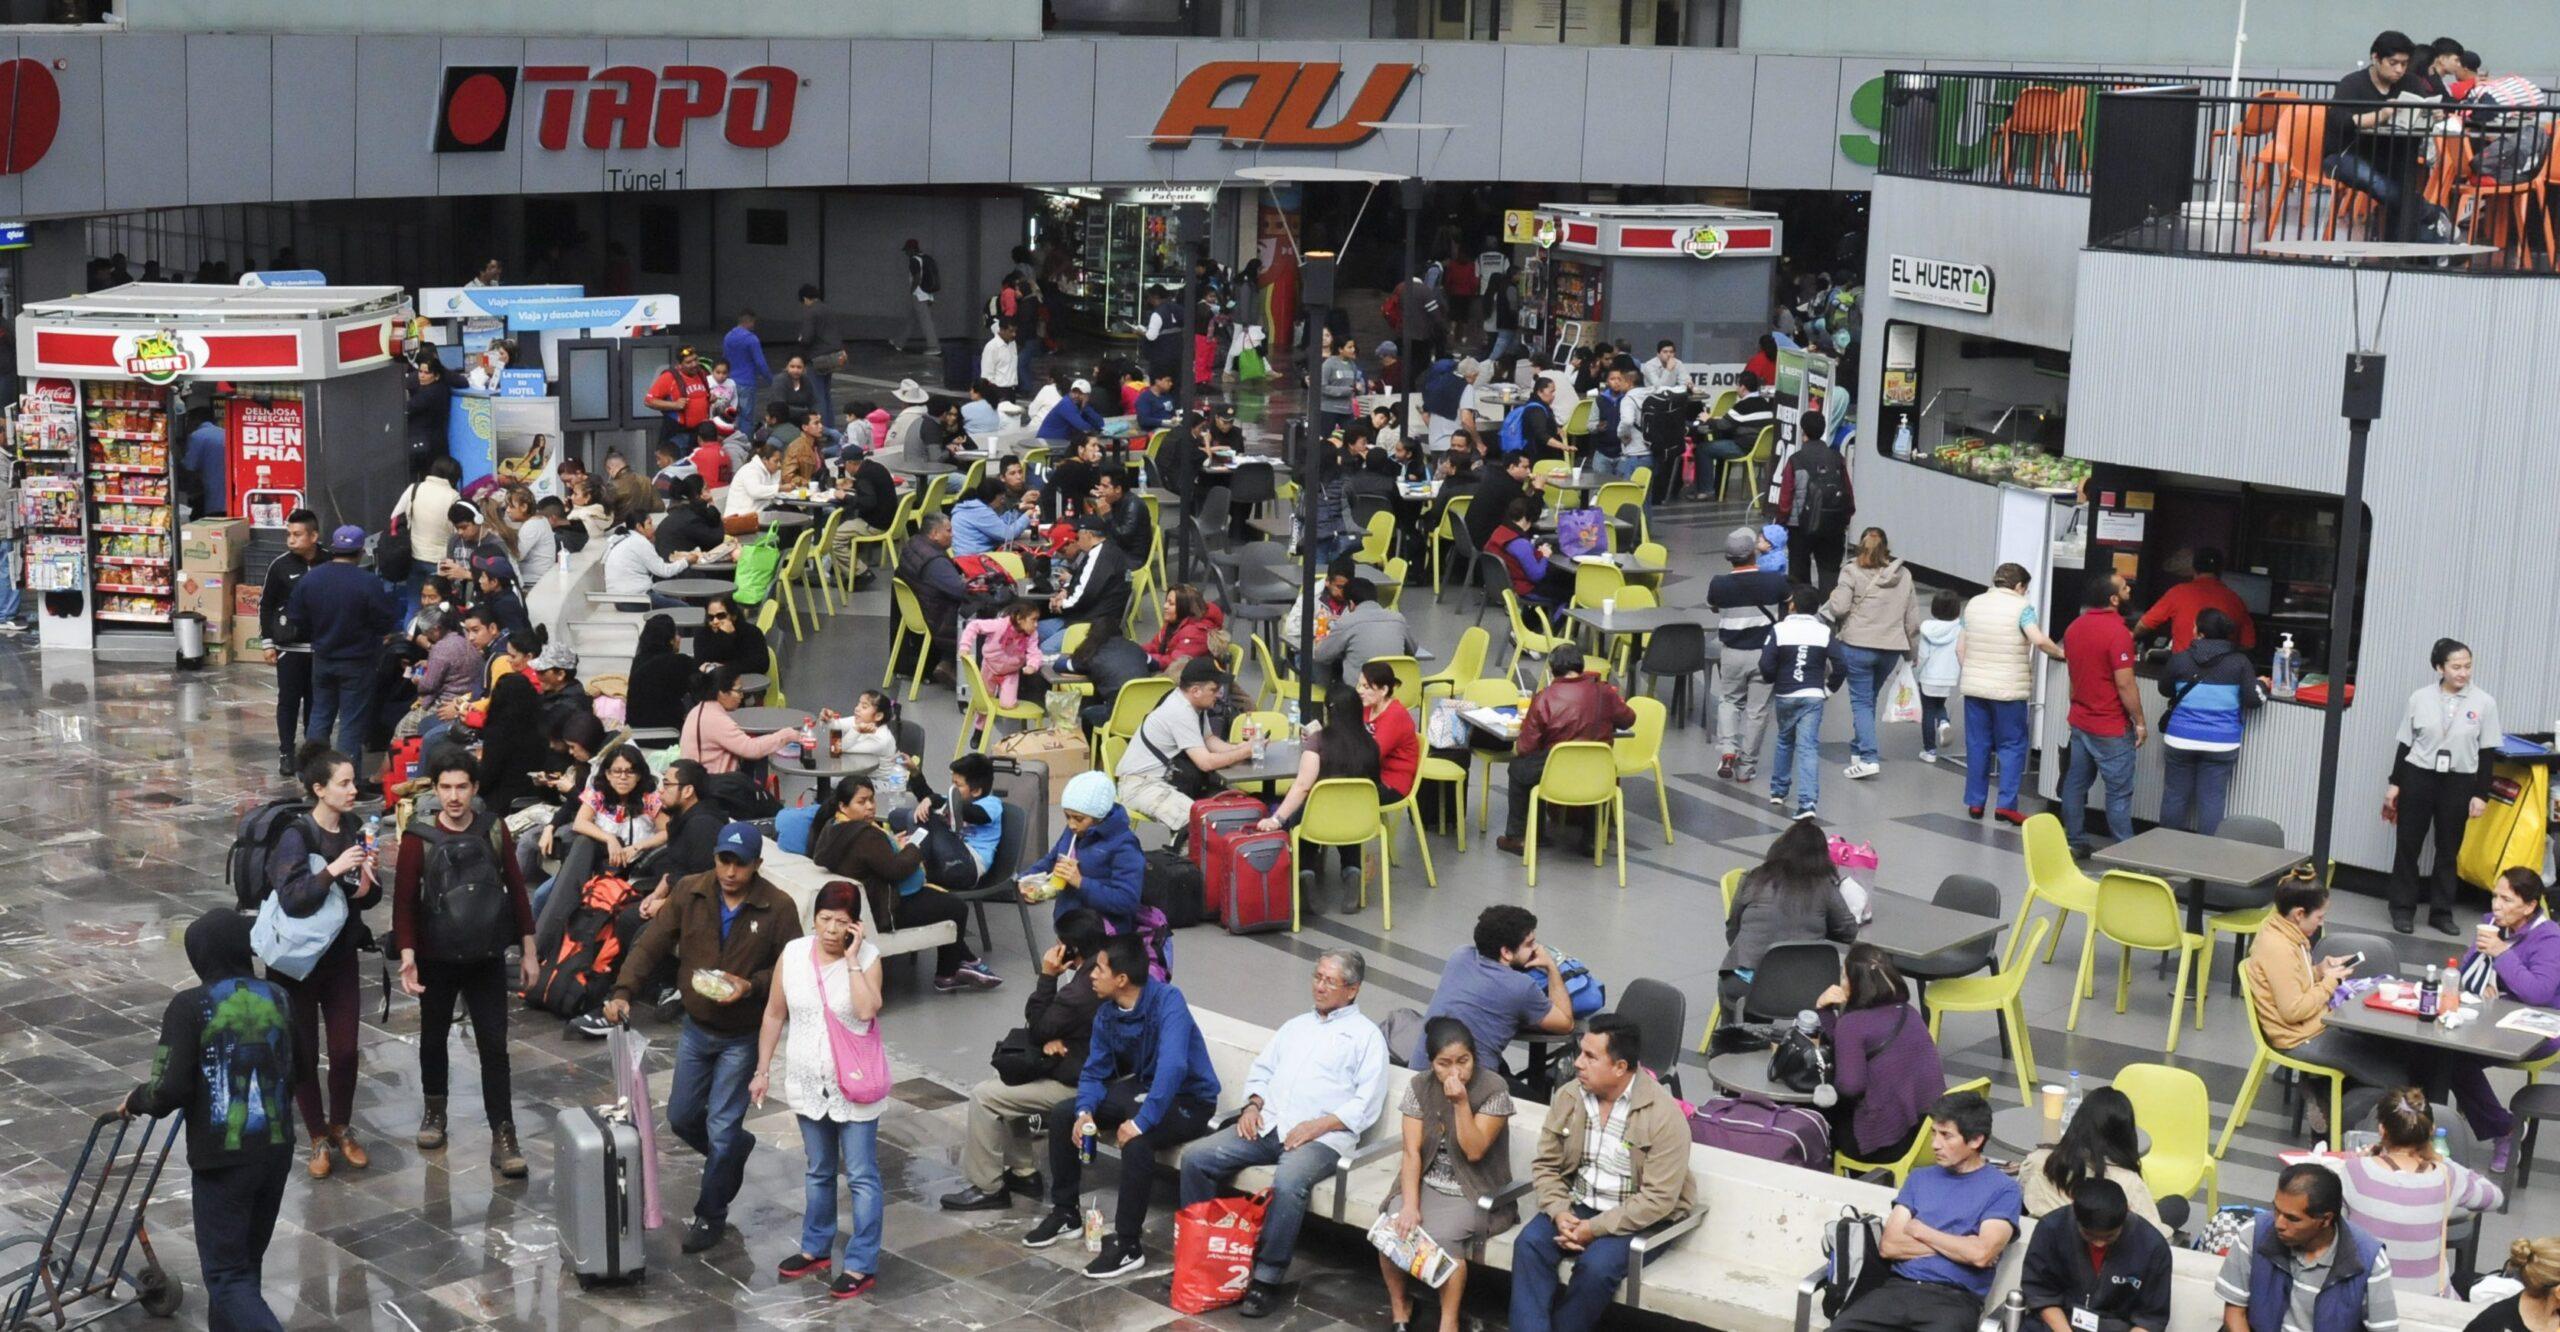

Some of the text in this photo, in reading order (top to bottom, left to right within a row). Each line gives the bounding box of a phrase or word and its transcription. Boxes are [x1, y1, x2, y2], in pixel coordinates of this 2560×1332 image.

[523, 66, 798, 150] TAPO
[1149, 61, 1415, 148] AU
[607, 168, 683, 191] Túnel 1
[1892, 258, 1986, 295] EL HUERTO
[519, 307, 620, 322] Viaja y descubre México
[508, 387, 536, 395] HOTEL
[242, 415, 301, 423] REFRESCANTE
[245, 407, 297, 416] DELICIOSA
[242, 426, 302, 446] BIEN
[242, 445, 302, 461] FRÍA
